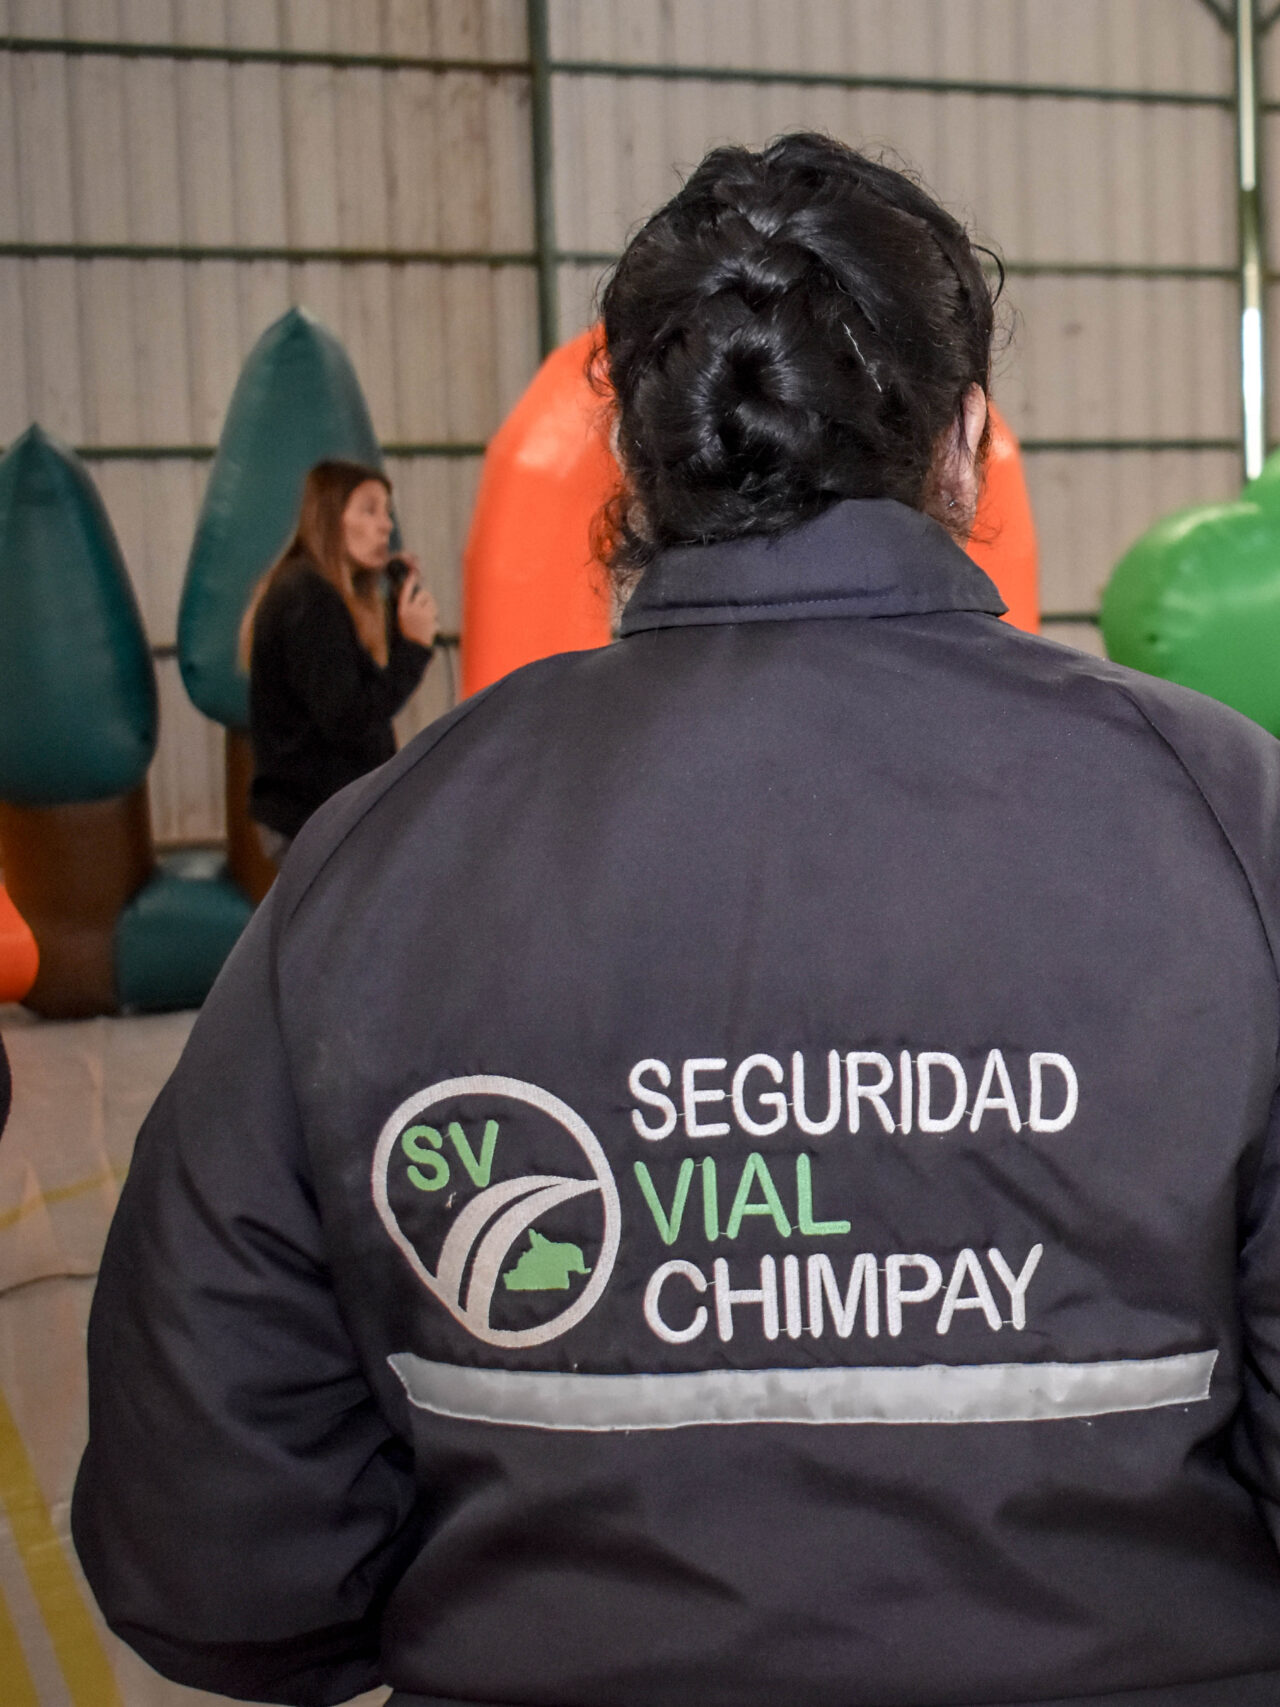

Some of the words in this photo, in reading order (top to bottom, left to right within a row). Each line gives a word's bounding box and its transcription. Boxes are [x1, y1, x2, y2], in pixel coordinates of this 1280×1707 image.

[628, 1049, 1079, 1141] SEGURIDAD
[402, 1119, 499, 1192] SV
[635, 1152, 851, 1245] VIAL
[643, 1243, 1044, 1344] CHIMPAY
